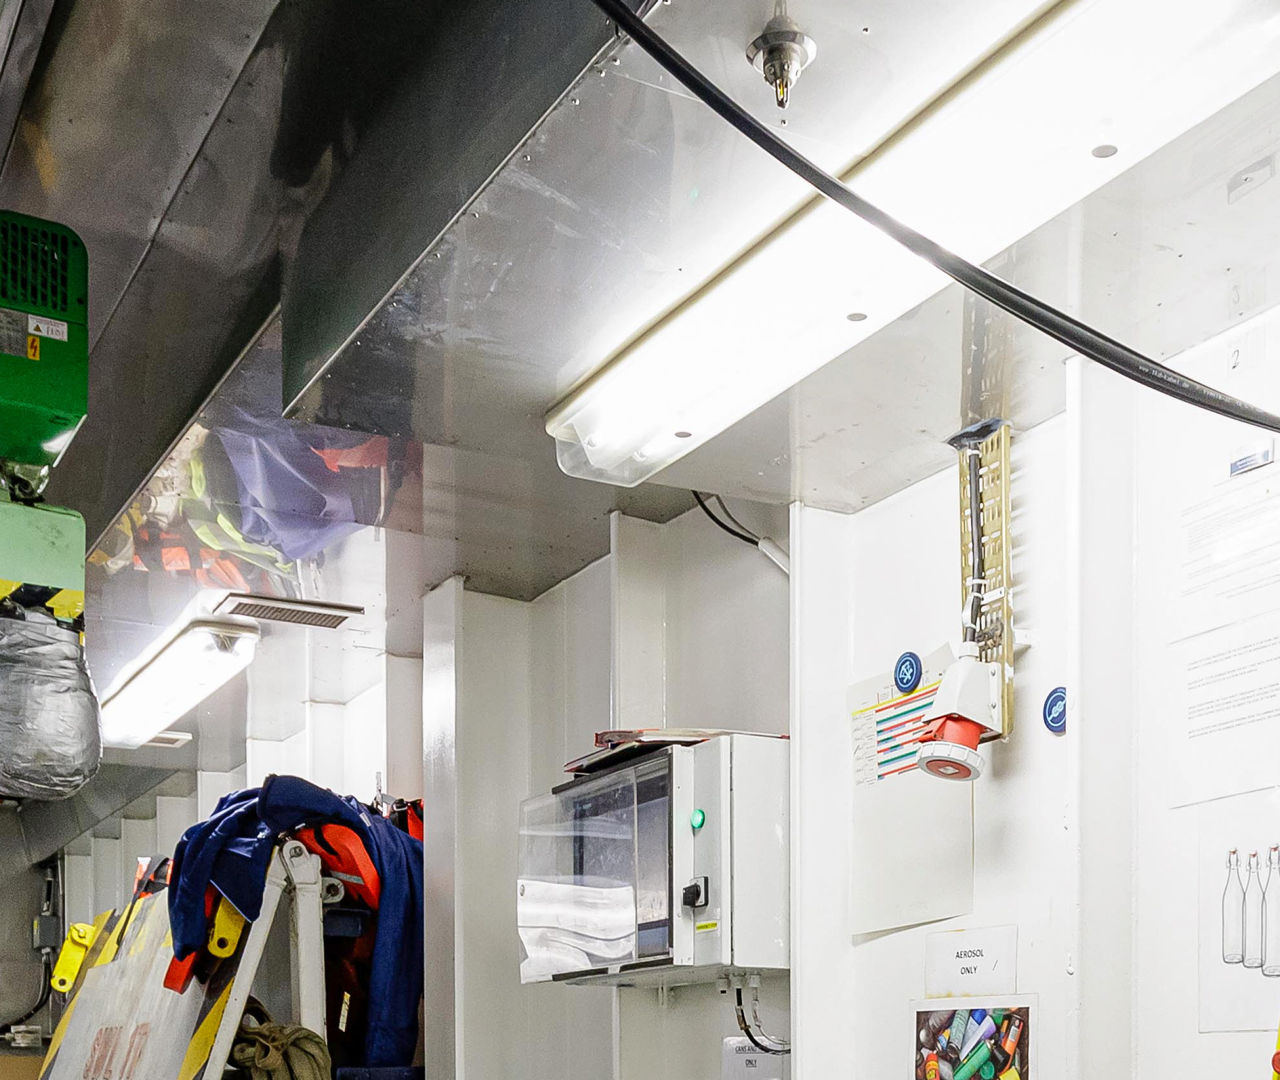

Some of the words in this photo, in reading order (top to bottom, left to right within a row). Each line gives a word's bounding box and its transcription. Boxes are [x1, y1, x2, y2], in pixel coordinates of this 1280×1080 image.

[955, 949, 984, 960] AEROSOL
[960, 966, 978, 975] ONLY
[745, 1059, 757, 1067] ONLY
